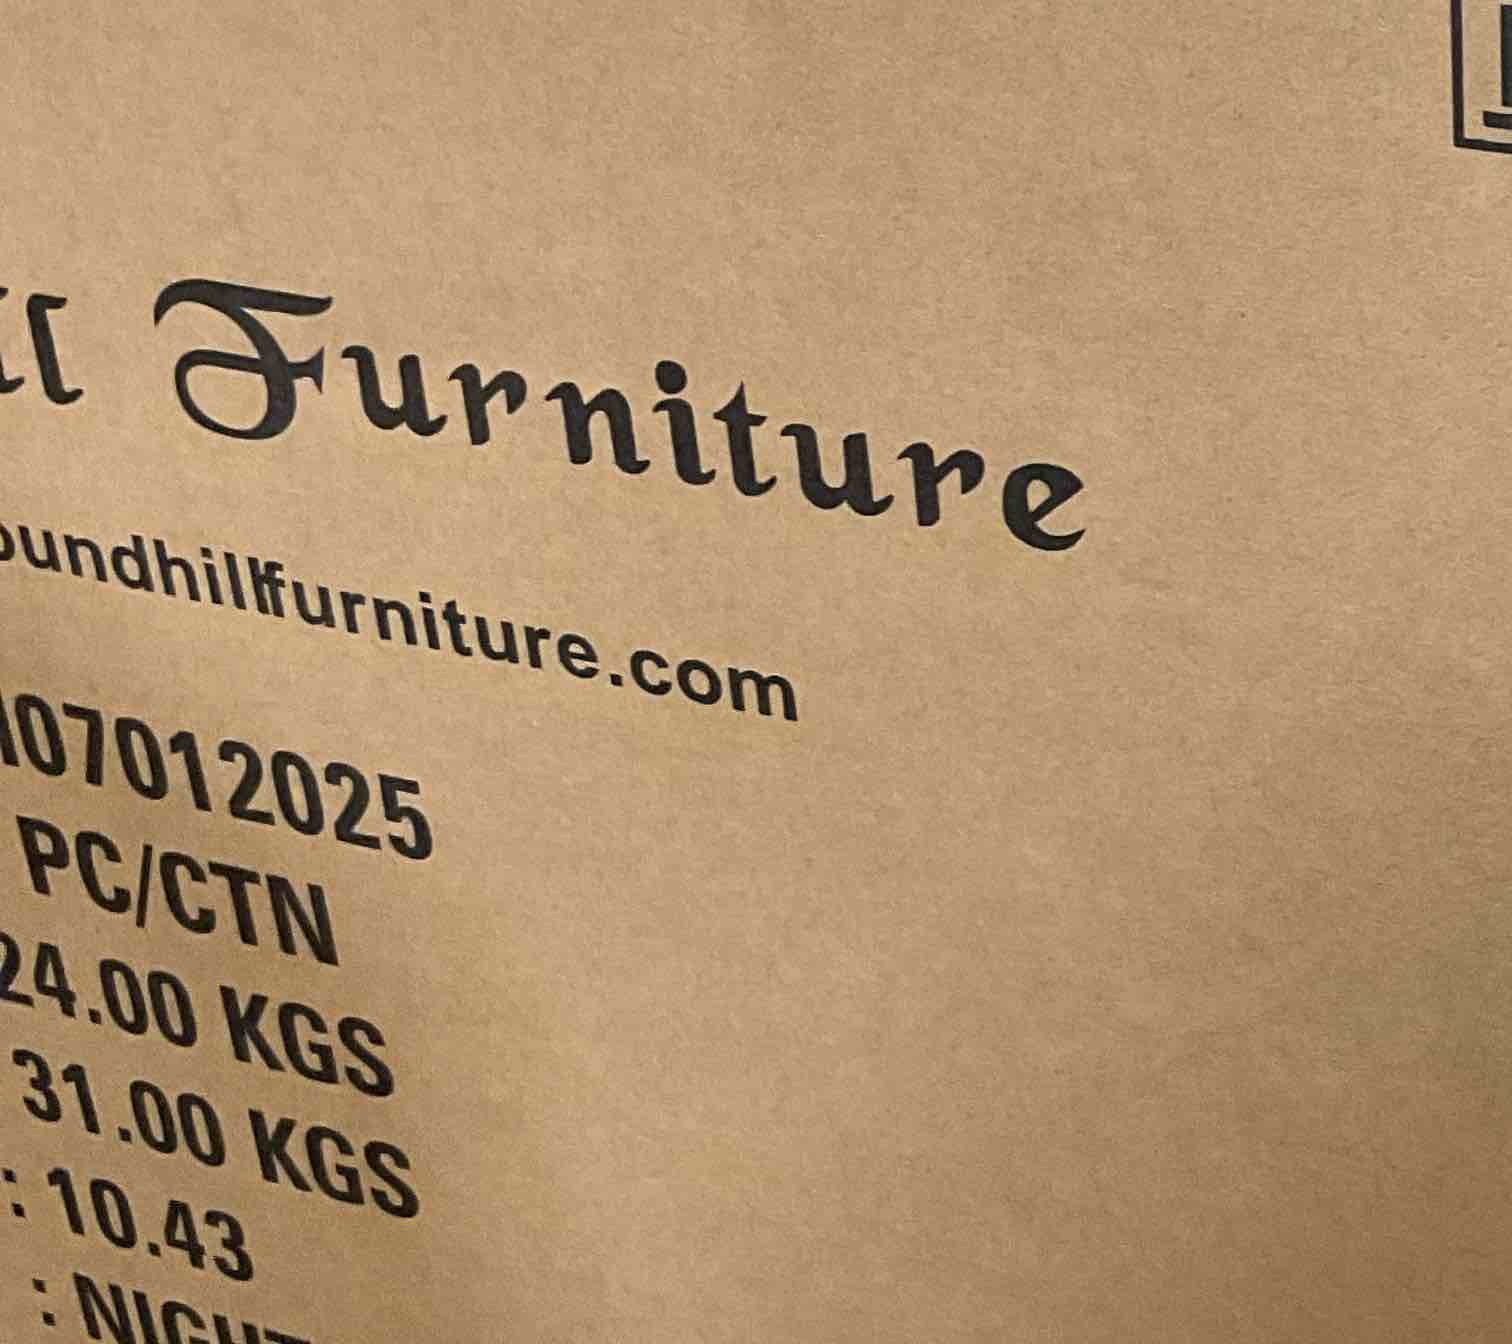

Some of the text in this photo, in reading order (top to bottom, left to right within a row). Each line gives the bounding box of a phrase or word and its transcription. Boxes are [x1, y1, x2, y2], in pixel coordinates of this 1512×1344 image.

[153, 278, 1086, 552] Furniture
[15, 814, 339, 967] PC/CTN
[0, 931, 394, 1098] 24.00 KGS
[12, 1049, 419, 1219] 31.00 KGS
[46, 1167, 254, 1282] 10.43
